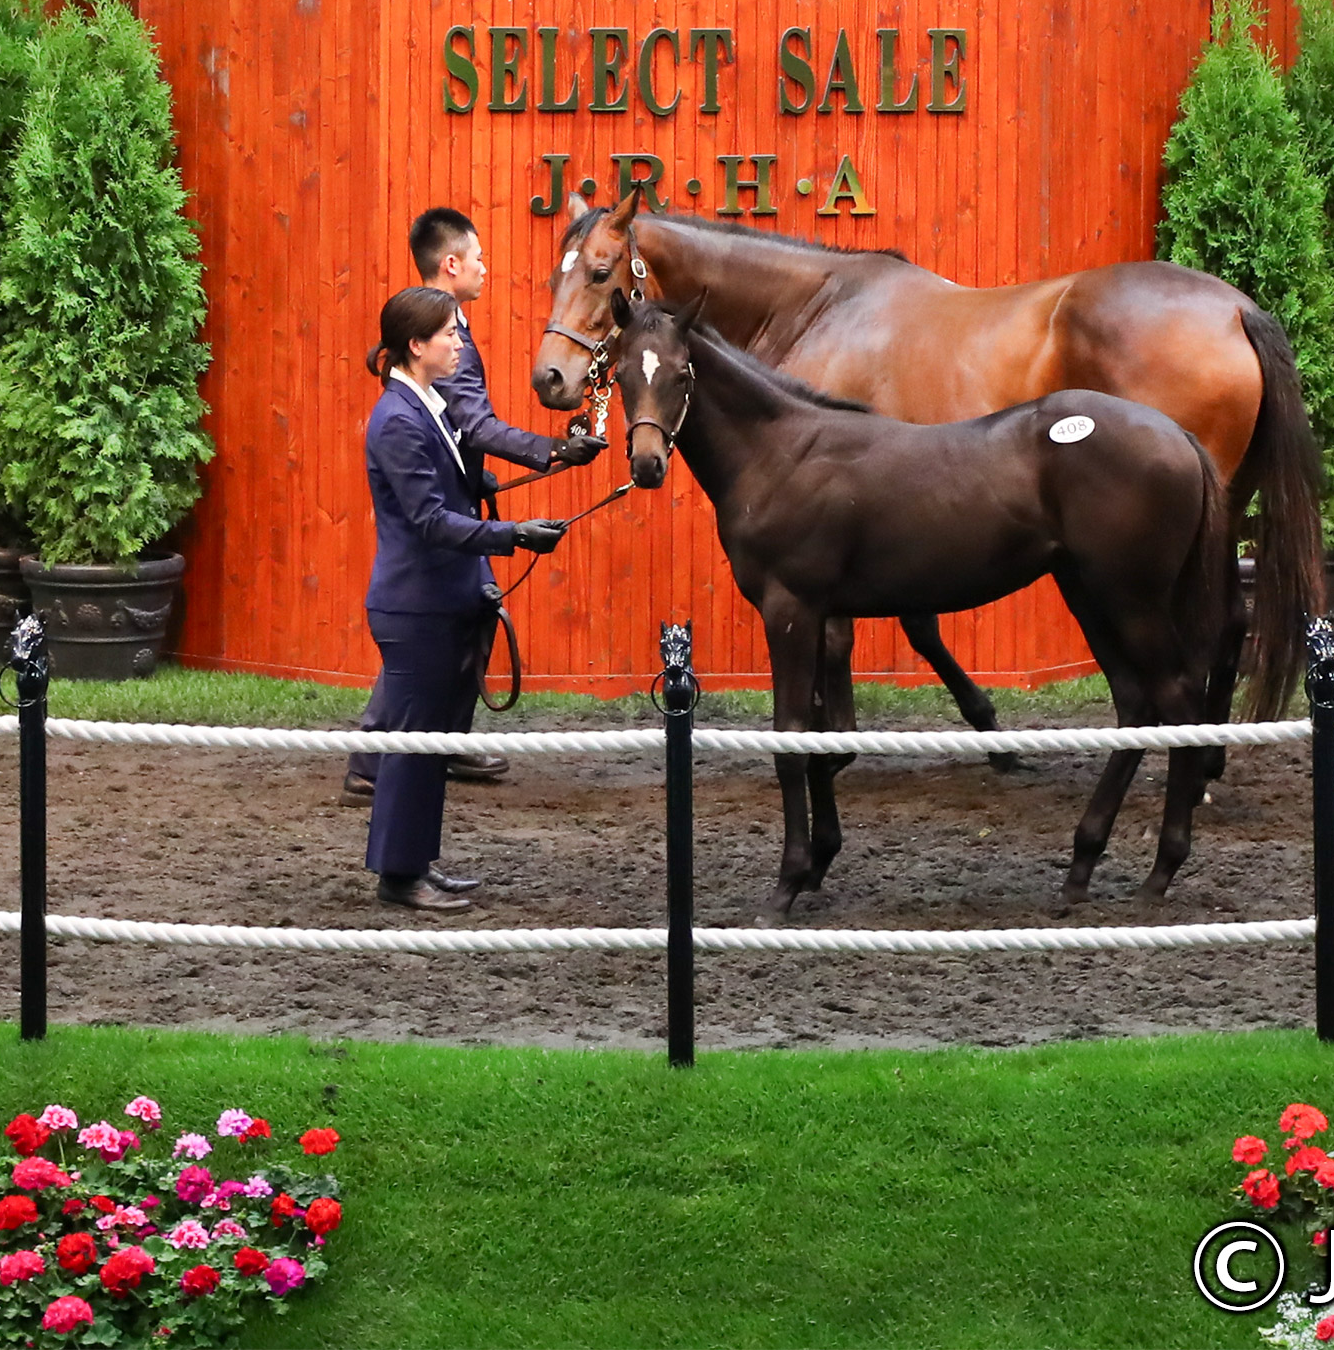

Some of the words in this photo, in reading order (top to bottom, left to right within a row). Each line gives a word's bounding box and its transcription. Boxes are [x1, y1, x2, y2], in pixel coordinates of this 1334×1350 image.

[443, 25, 734, 119] SELECT
[778, 25, 968, 117] SALE
[1057, 419, 1087, 436] 408
